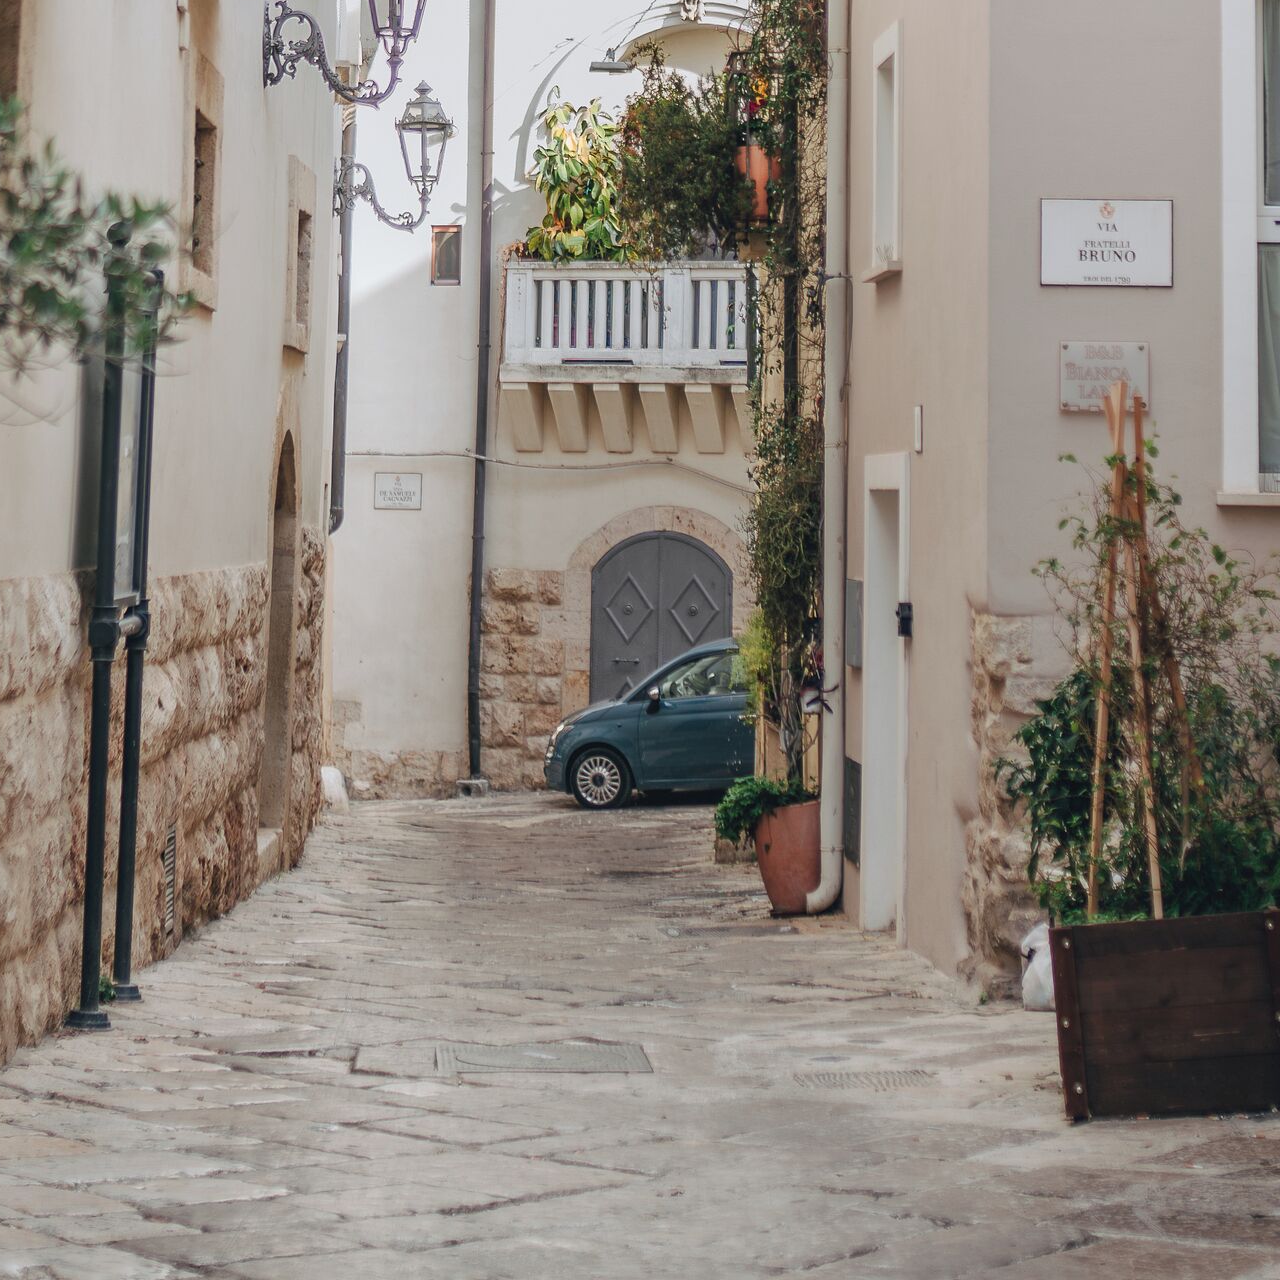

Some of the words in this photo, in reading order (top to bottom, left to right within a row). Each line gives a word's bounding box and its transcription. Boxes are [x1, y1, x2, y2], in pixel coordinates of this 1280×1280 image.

[1097, 223, 1119, 232] VIA
[1084, 240, 1131, 249] FRATELLI
[1079, 250, 1136, 263] BRUNO
[1084, 345, 1123, 360] B&B
[1065, 366, 1132, 381] BIANCA
[1078, 384, 1141, 400] LANIA
